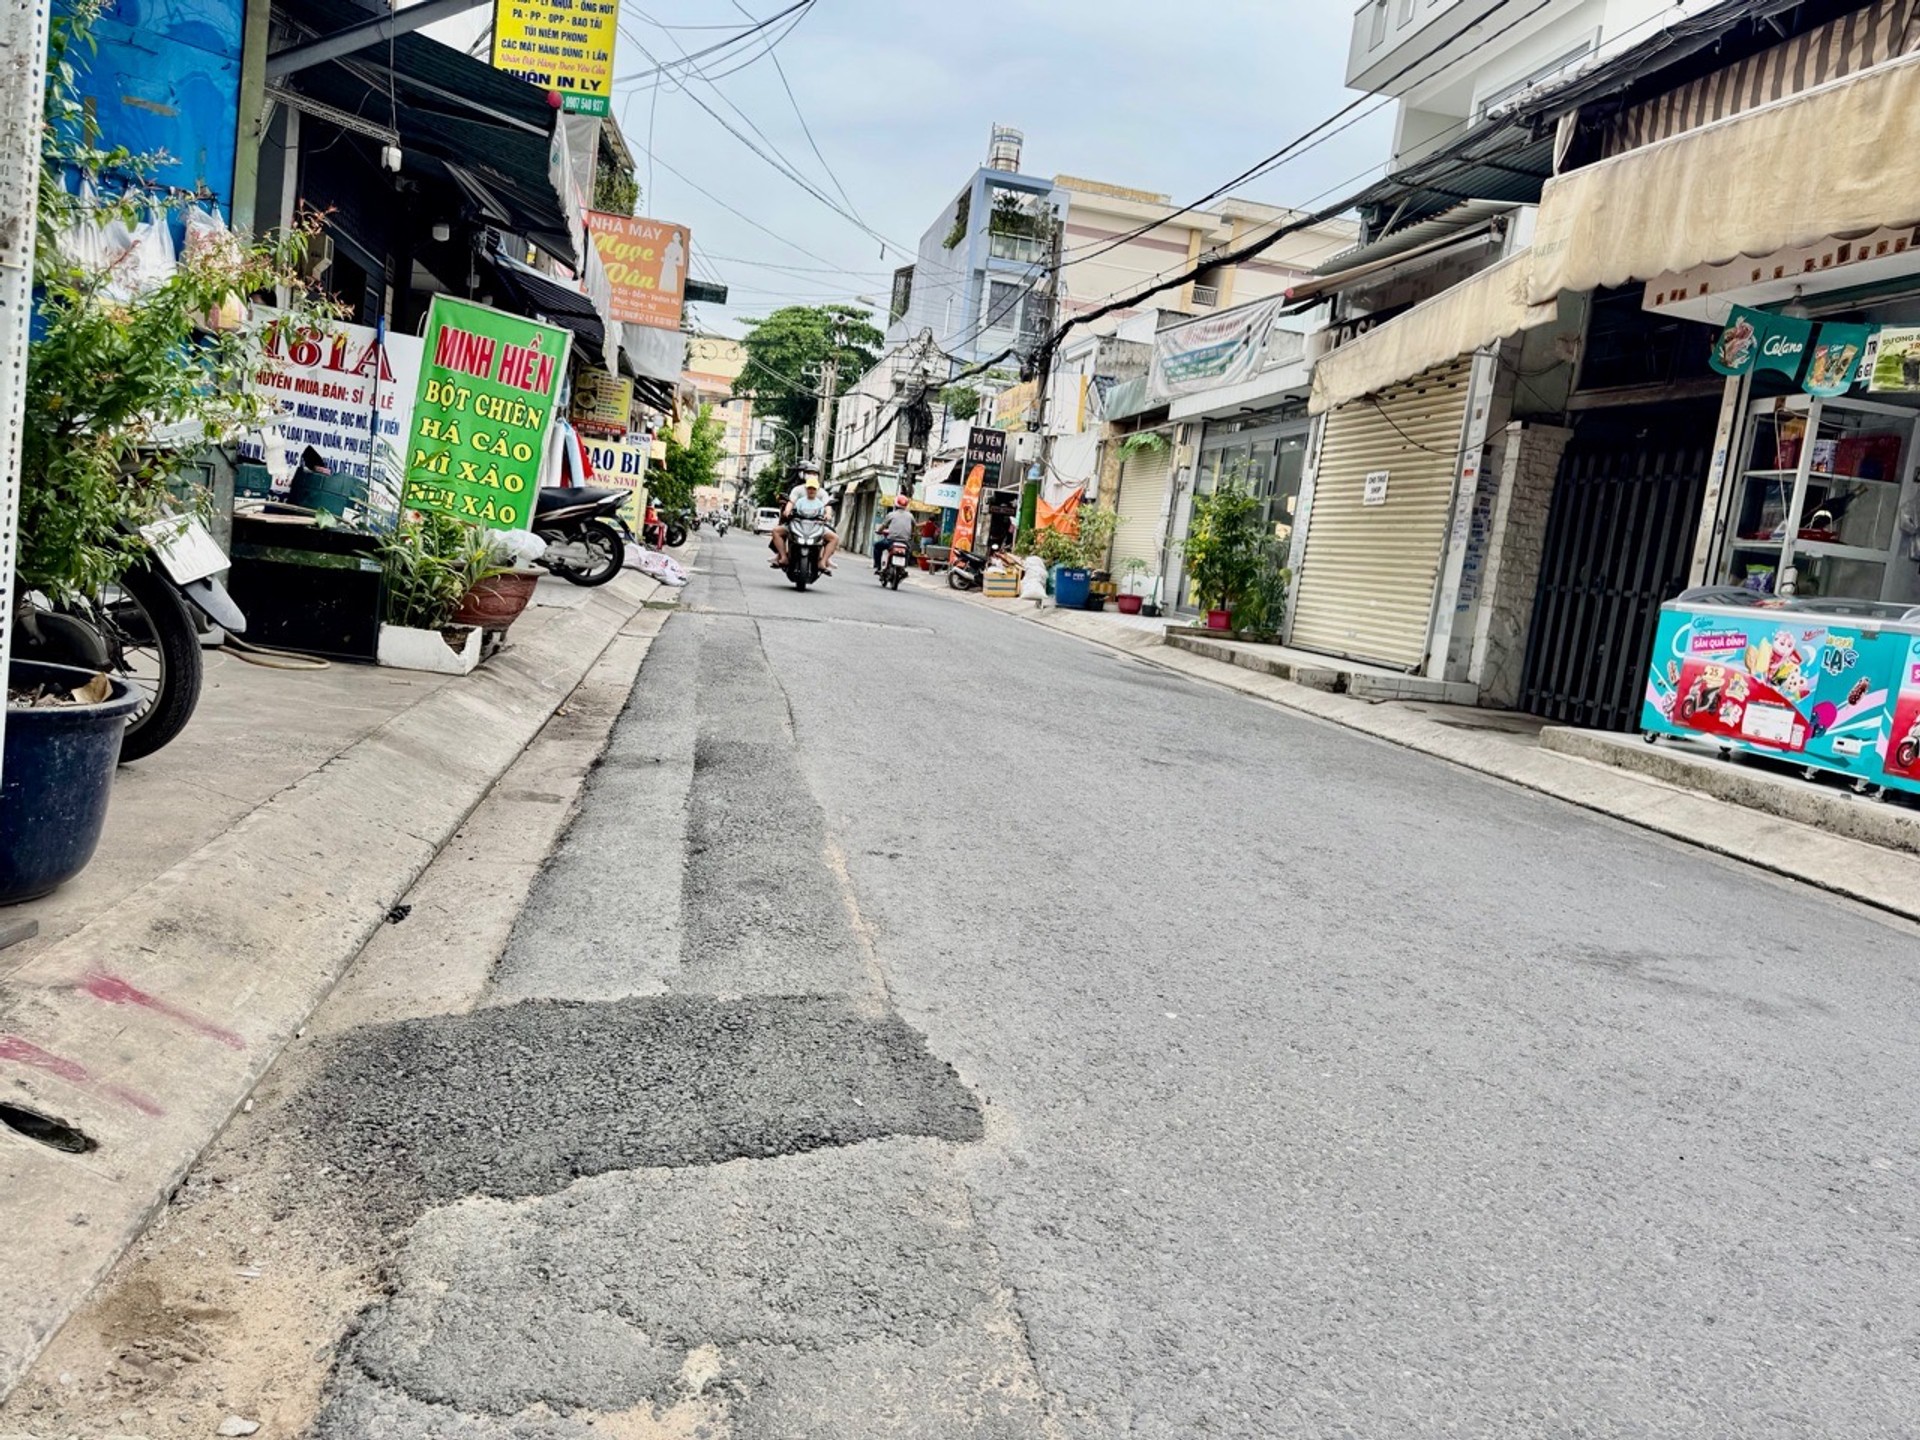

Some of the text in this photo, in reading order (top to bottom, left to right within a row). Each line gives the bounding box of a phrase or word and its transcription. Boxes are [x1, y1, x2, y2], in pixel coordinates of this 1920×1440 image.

[557, 76, 575, 88] IN
[581, 79, 602, 91] LY
[591, 216, 663, 241] NHÀ MAY
[433, 325, 497, 380] MINH
[498, 331, 556, 397] HIỀN
[295, 378, 320, 396] MUA
[322, 382, 349, 401] BÁN:
[424, 377, 471, 413] BỘT
[474, 396, 544, 431] CHIÊN
[419, 416, 461, 446] HÁ
[471, 430, 534, 462] CẢO
[621, 449, 641, 475] BÌ
[456, 460, 525, 494] XÀO
[460, 495, 518, 524] XÀO
